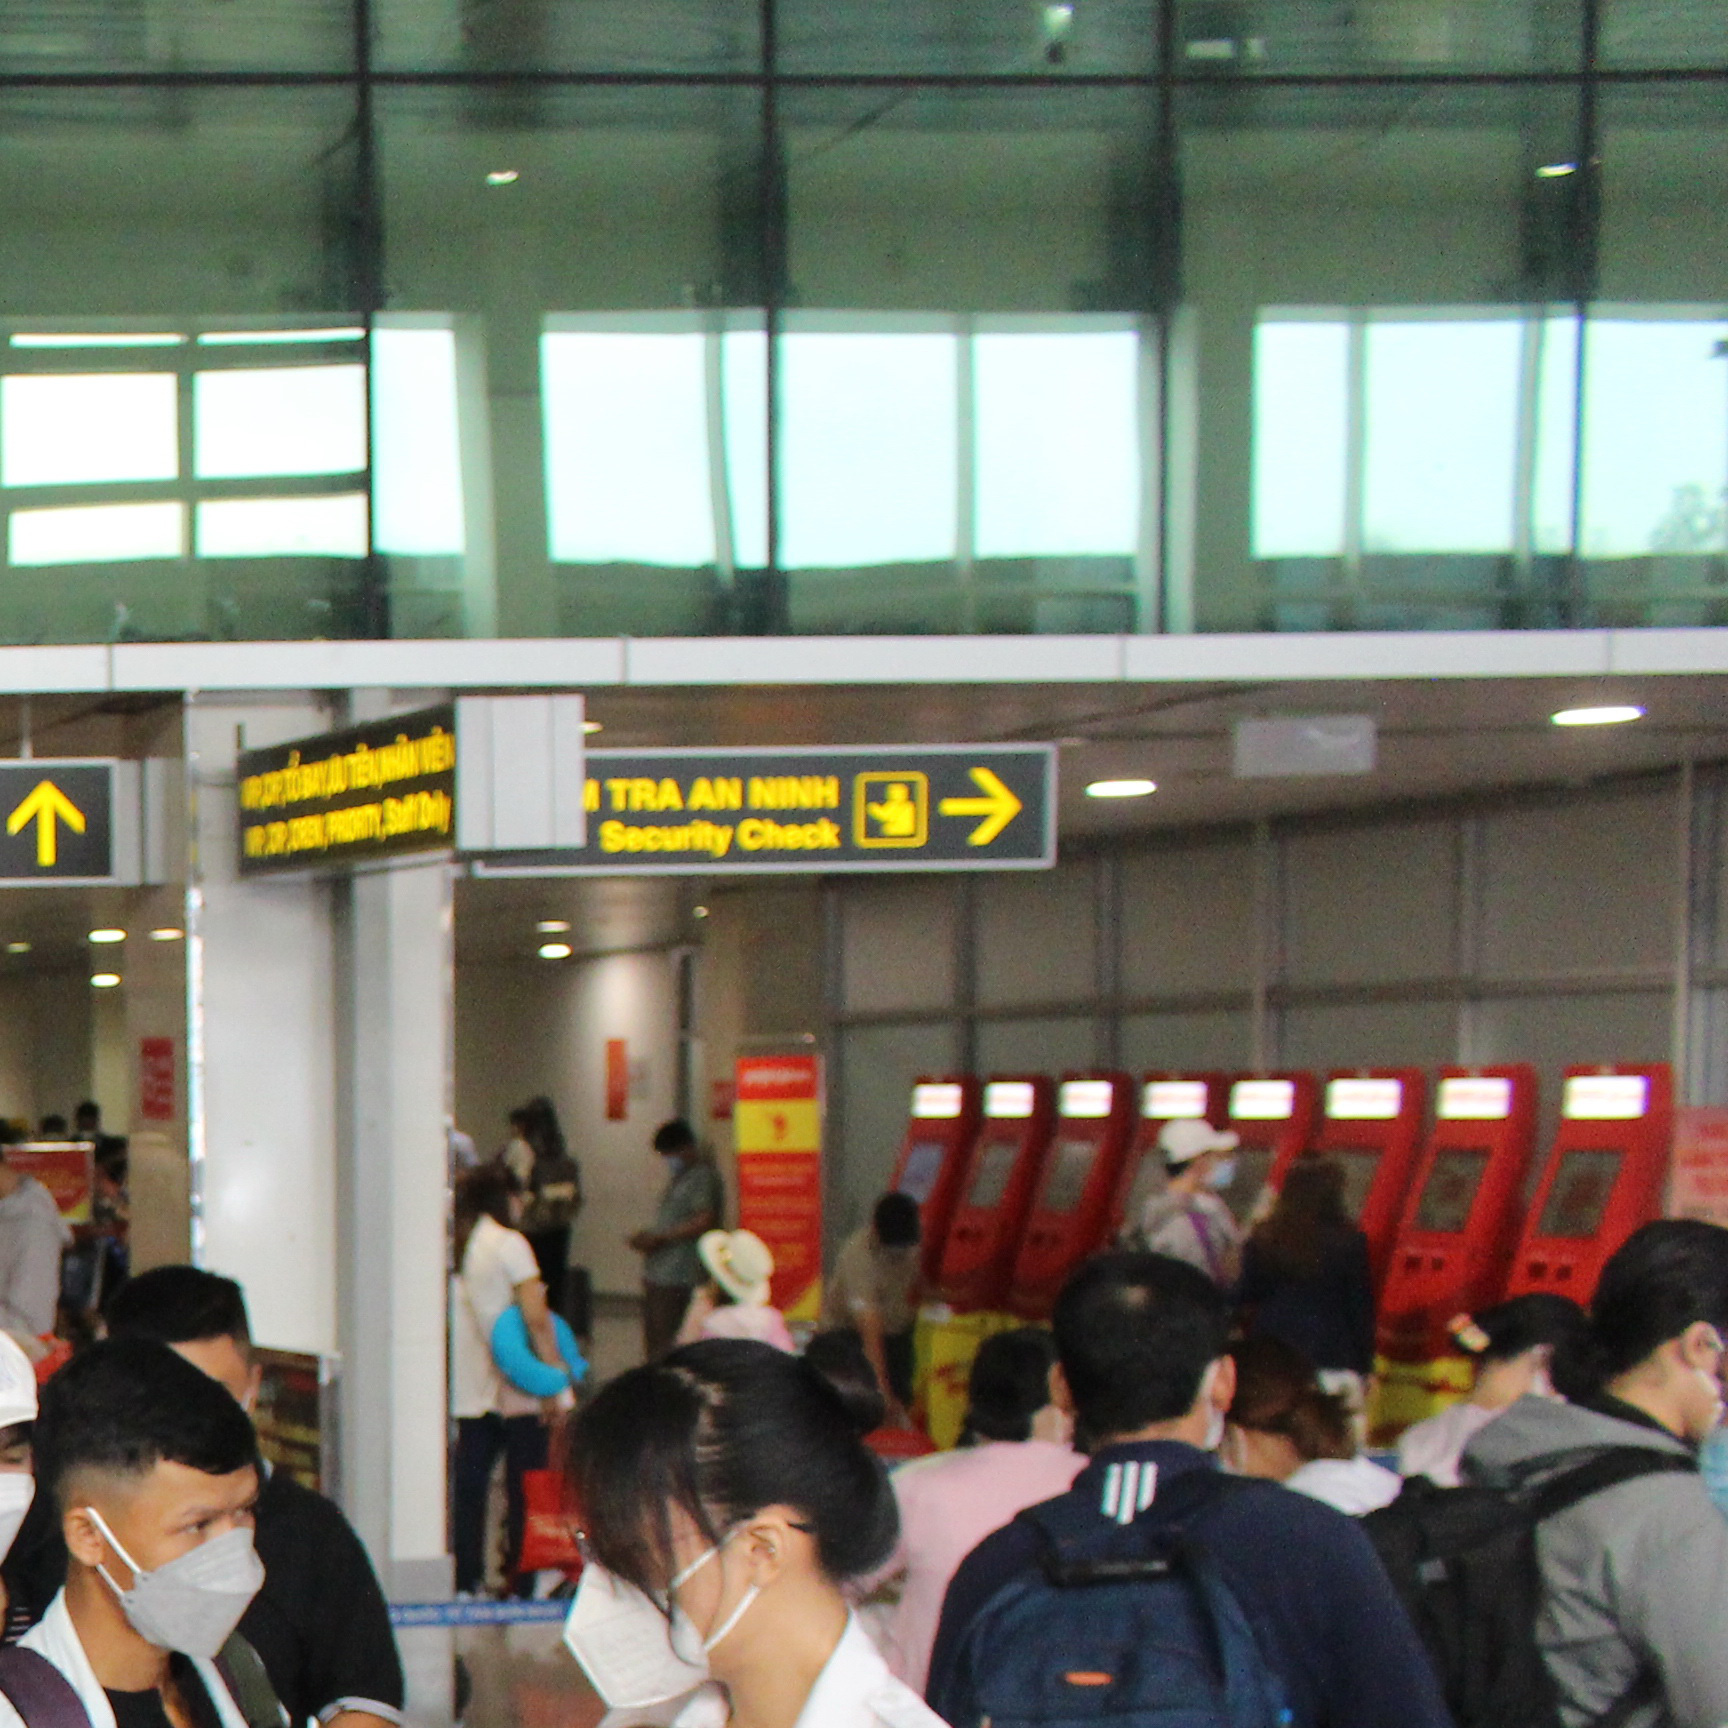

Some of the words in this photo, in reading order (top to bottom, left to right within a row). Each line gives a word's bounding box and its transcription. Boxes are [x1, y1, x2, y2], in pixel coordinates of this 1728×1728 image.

[605, 777, 684, 811] TRA
[687, 775, 743, 811] AN
[748, 775, 841, 810] NINH
[599, 818, 734, 858] Security
[735, 817, 841, 851] Check
